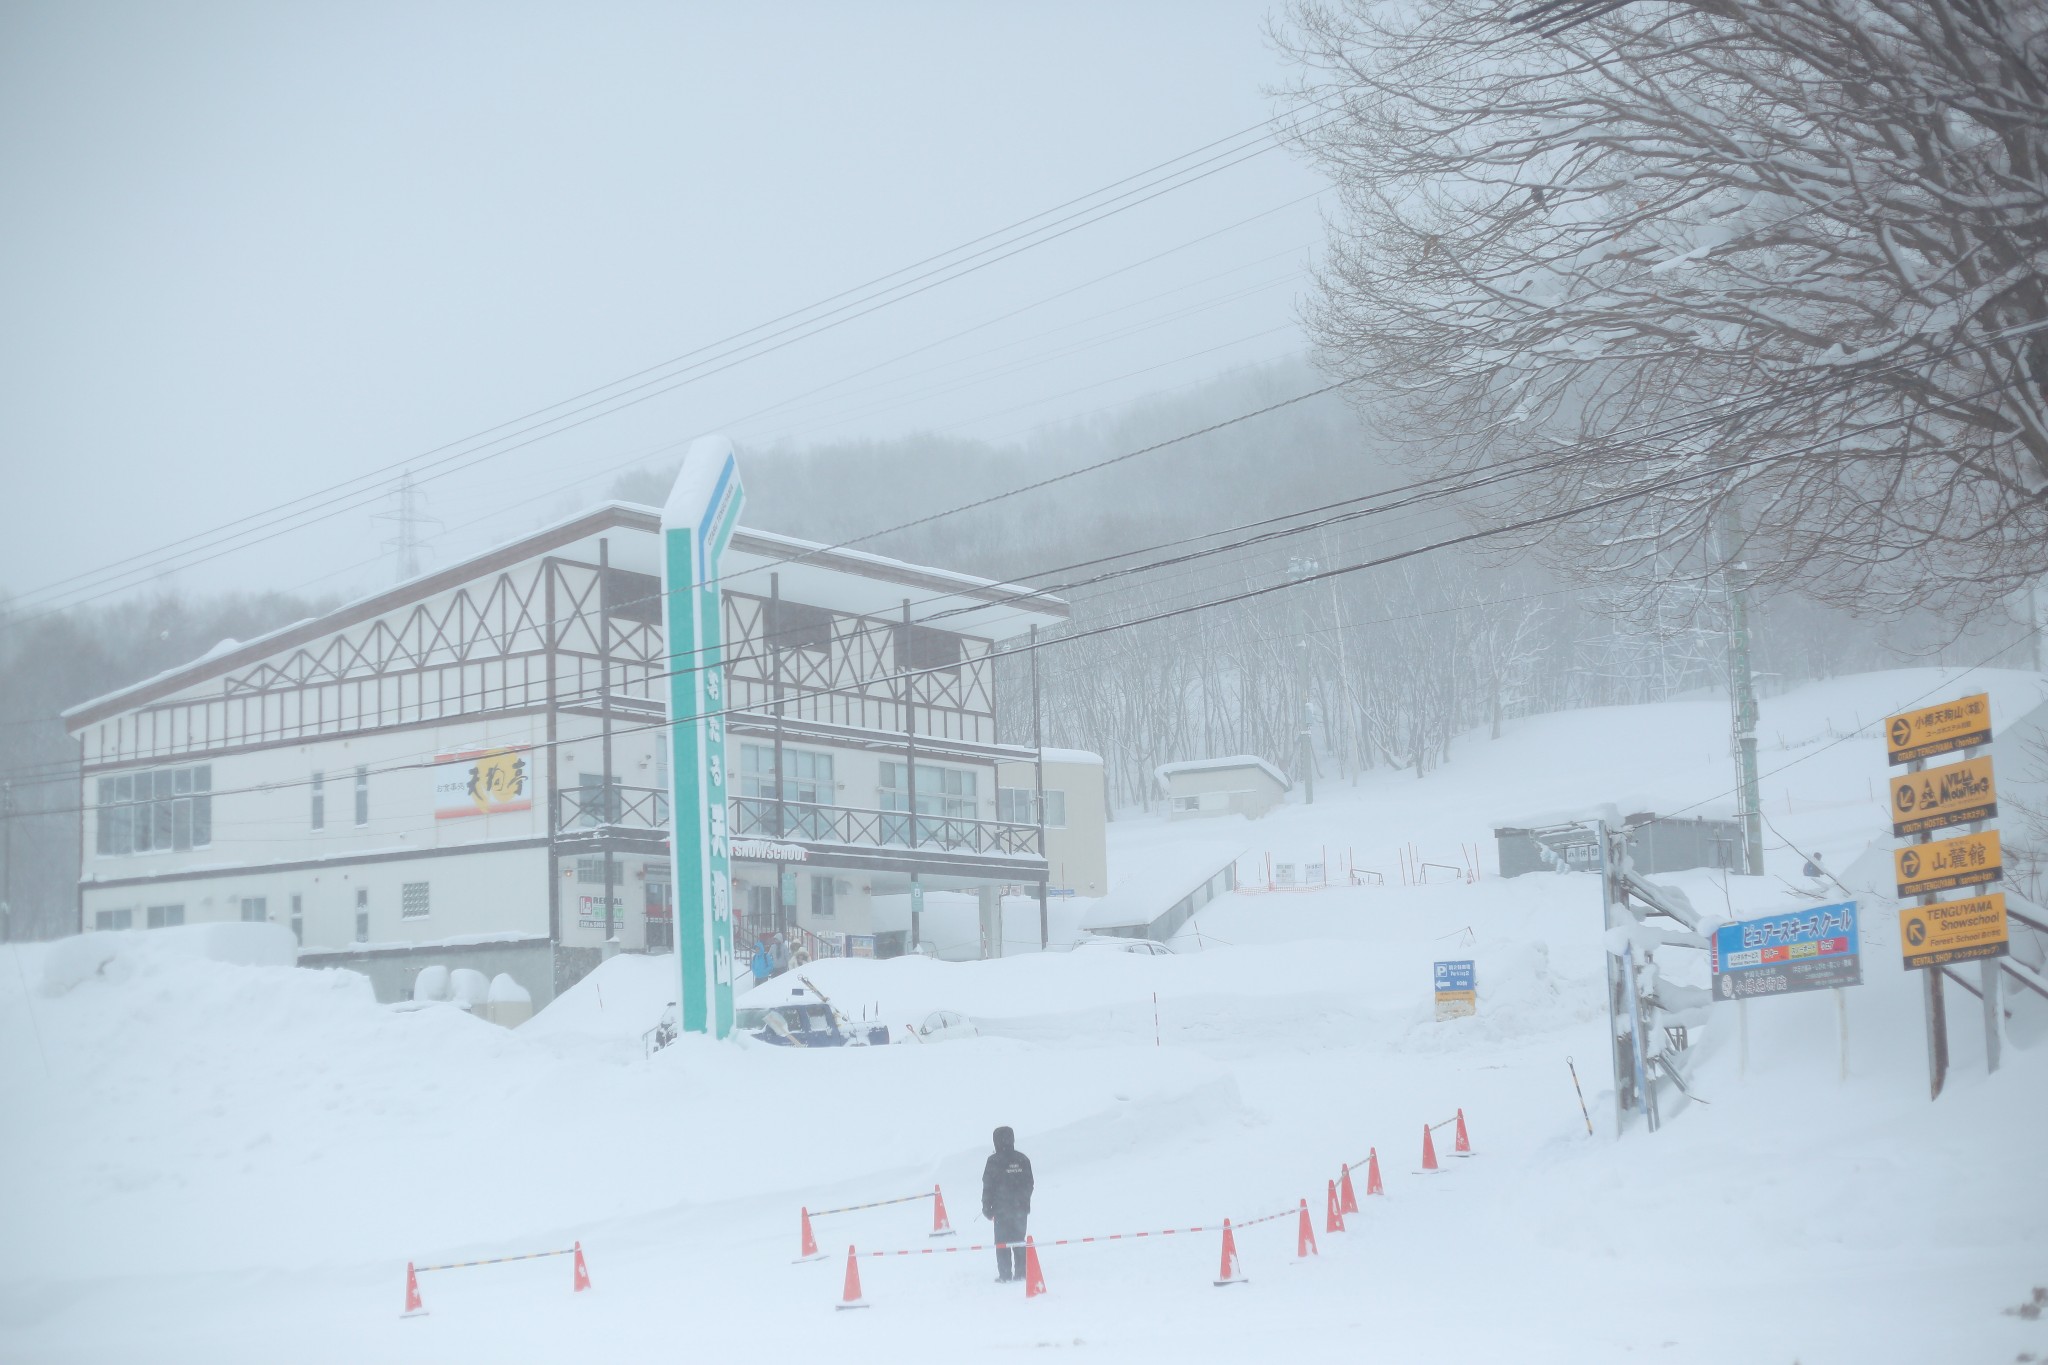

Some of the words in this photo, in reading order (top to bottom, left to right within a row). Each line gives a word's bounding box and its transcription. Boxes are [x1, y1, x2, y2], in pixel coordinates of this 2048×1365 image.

[436, 782, 465, 793] お食事処
[707, 670, 731, 987] おたる天狗山
[1902, 824, 1922, 834] YOUTH
[1924, 817, 1948, 829] HOSTEL
[1932, 842, 1986, 870] 山麓館
[593, 896, 623, 905] REAL
[1926, 900, 1993, 921] TENGUYAMA
[1743, 909, 1853, 948] ピュアースキースクール
[1940, 912, 2000, 931] Snowschool
[1930, 937, 1954, 947] Forest
[1956, 934, 1981, 943] School
[1912, 956, 1935, 967] RENTAL
[1935, 953, 1952, 964] SHOP
